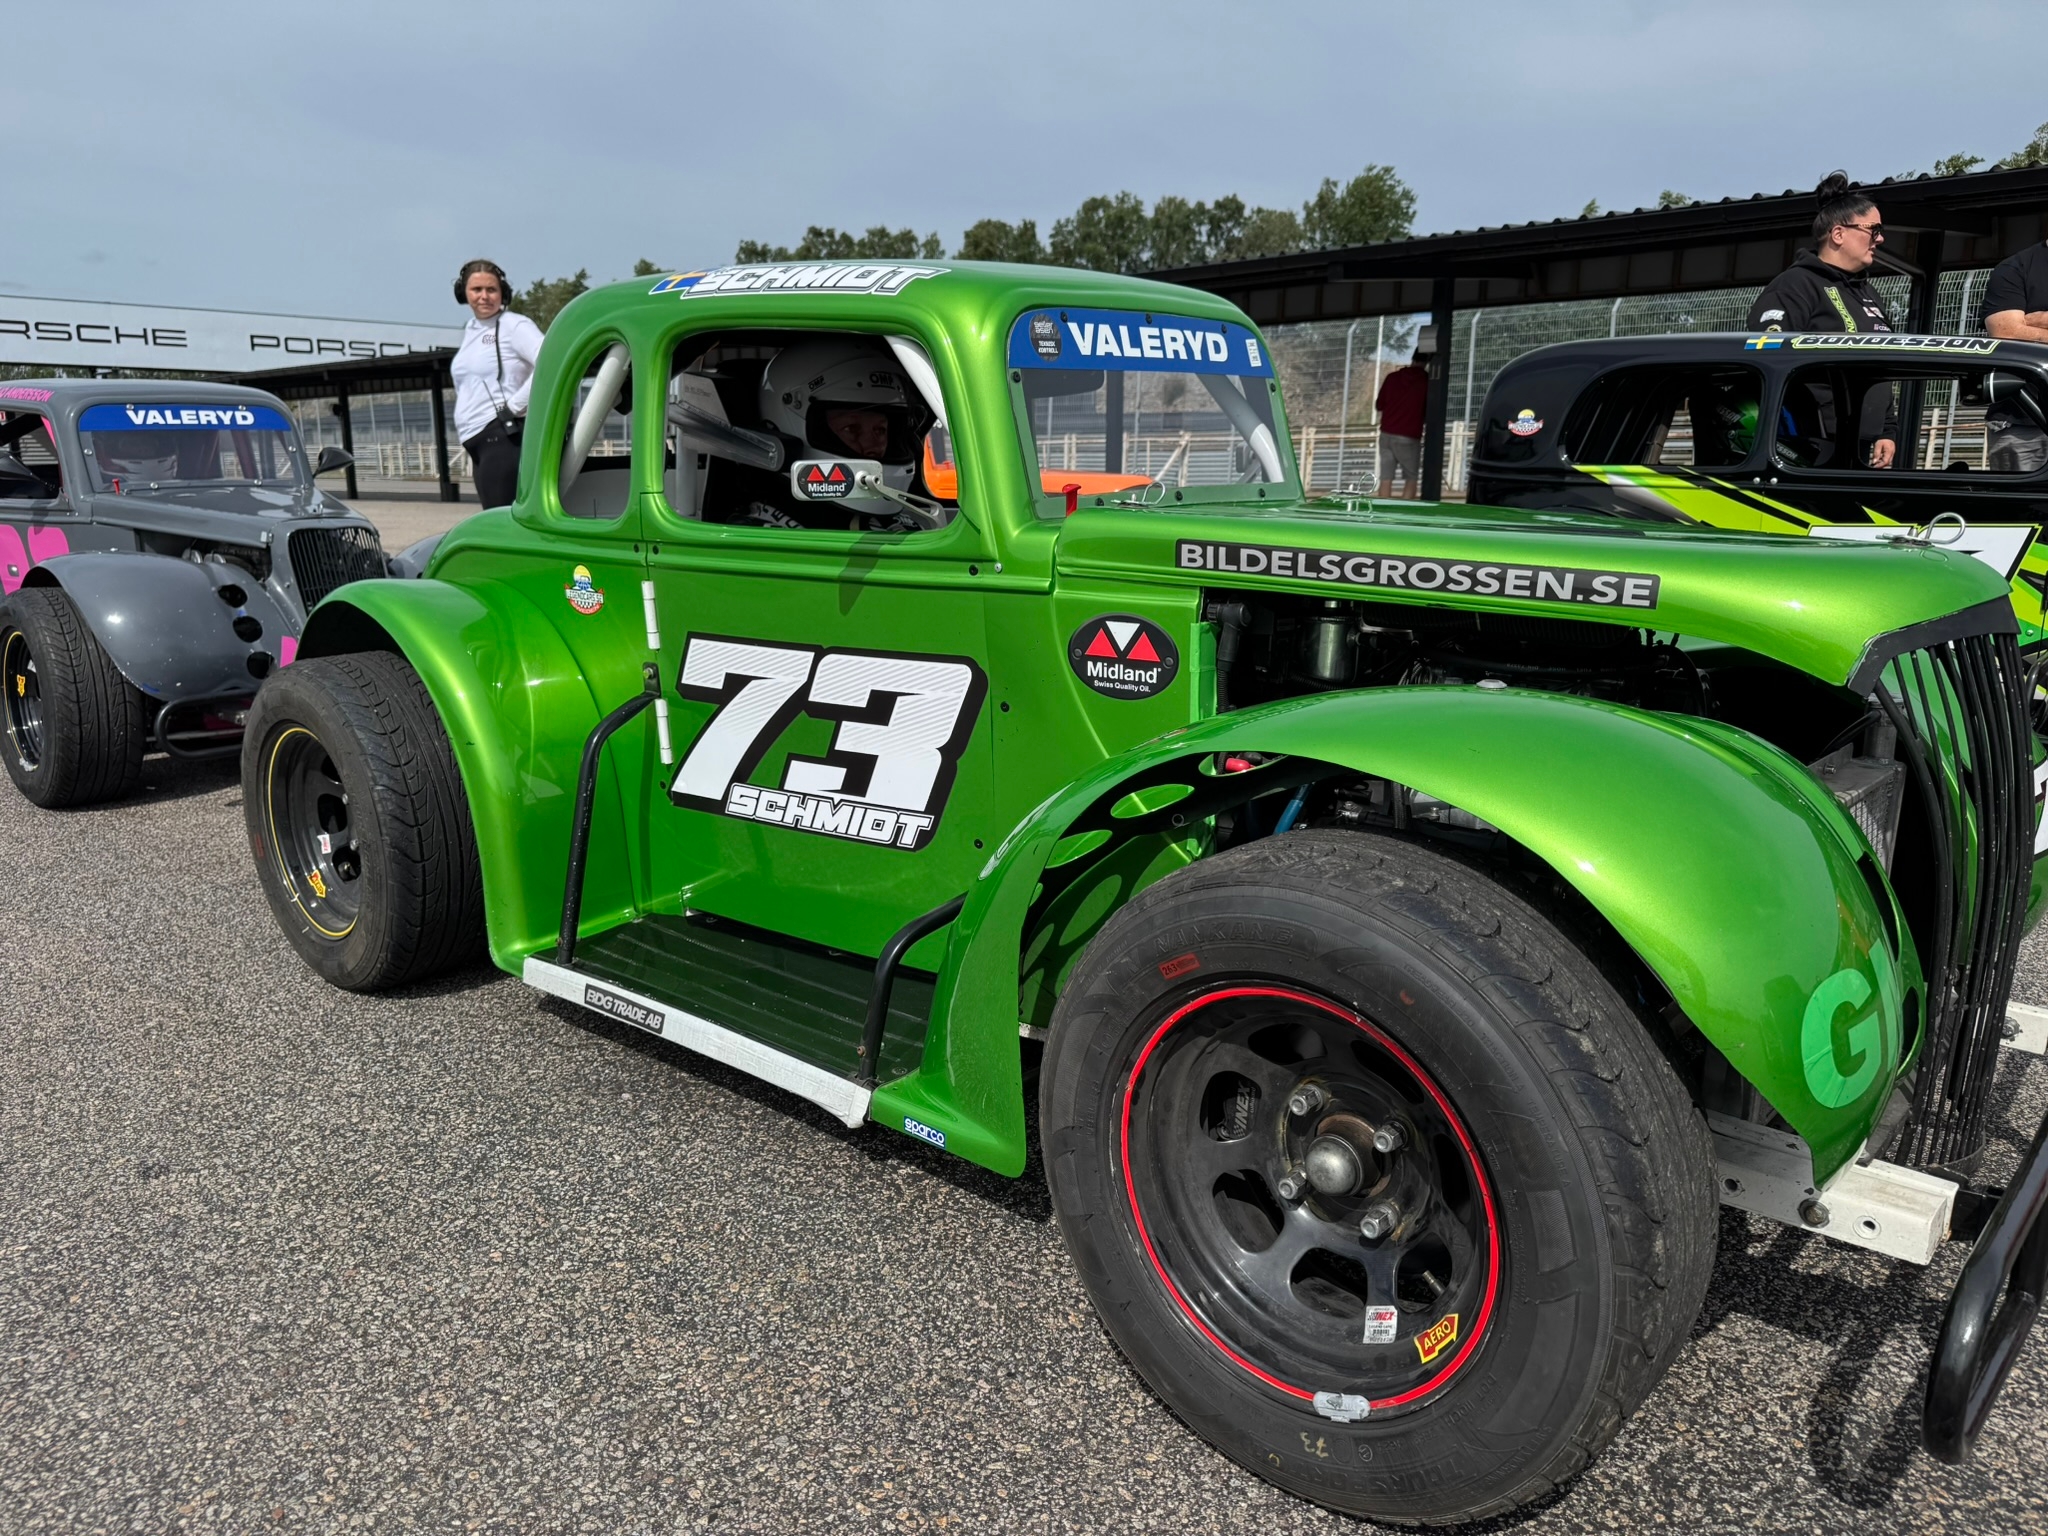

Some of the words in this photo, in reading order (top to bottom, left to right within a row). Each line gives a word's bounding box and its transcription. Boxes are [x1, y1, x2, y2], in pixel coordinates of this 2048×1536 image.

[685, 264, 945, 297] SCHMIDT
[250, 335, 461, 359] PORSCH
[1068, 322, 1229, 362] VALERYD
[1797, 336, 1998, 353] BONDESSON
[808, 375, 826, 390] OMP
[869, 370, 895, 386] OMP
[126, 409, 255, 425] VALERYD
[808, 482, 846, 493] Midland
[1180, 543, 1651, 608] BILDELSGROSSEN.SE
[1087, 660, 1158, 684] Midland
[1094, 680, 1114, 688] Swiss
[1114, 682, 1139, 692] Quality
[671, 637, 973, 812] 73
[726, 783, 934, 848] SCHMIDT
[1161, 962, 1179, 977] 263
[586, 989, 613, 1010] BDG
[613, 999, 647, 1024] TRADE
[645, 1013, 662, 1030] AB
[1234, 1080, 1251, 1130] INEX
[904, 1118, 945, 1144] sparco
[1375, 1312, 1395, 1321] INEX
[1424, 1321, 1451, 1350] AERO
[1300, 1431, 1329, 1458] 73
